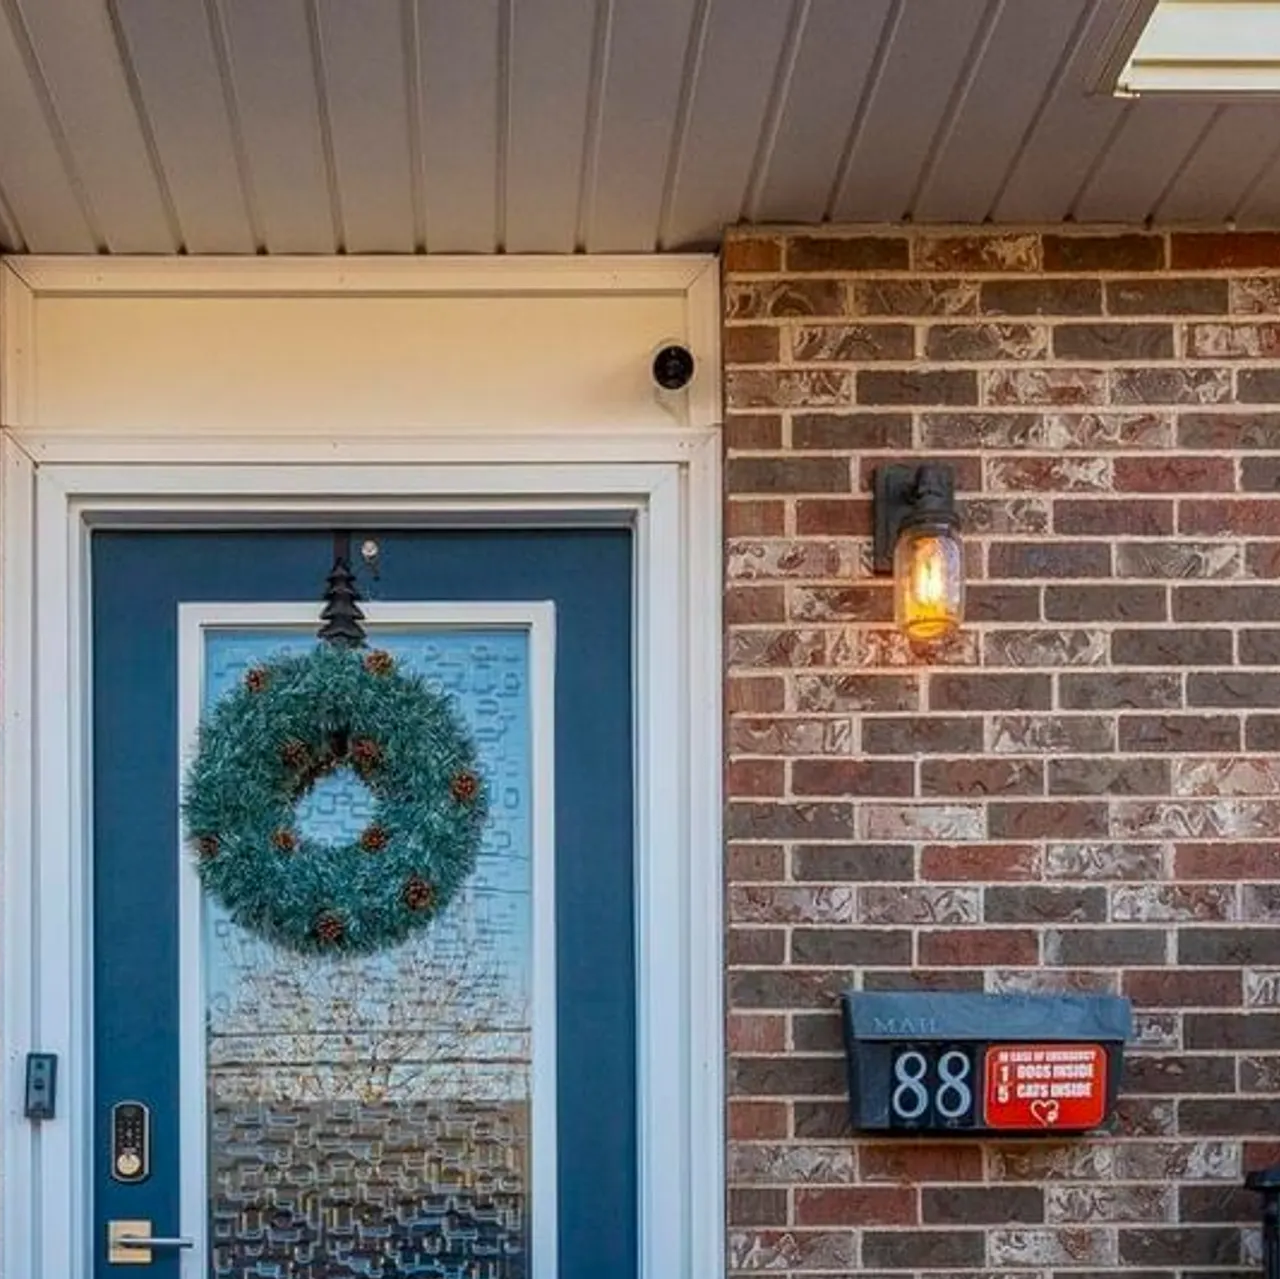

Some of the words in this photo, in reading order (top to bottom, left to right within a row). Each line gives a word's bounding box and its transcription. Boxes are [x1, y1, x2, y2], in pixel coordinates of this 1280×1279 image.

[1000, 1064, 1009, 1082] 1
[1016, 1064, 1052, 1079] DOGS
[1052, 1063, 1095, 1079] INSIDE
[892, 1050, 972, 1119] 88
[1016, 1083, 1049, 1098] CATS
[1050, 1082, 1093, 1098] INSIDE
